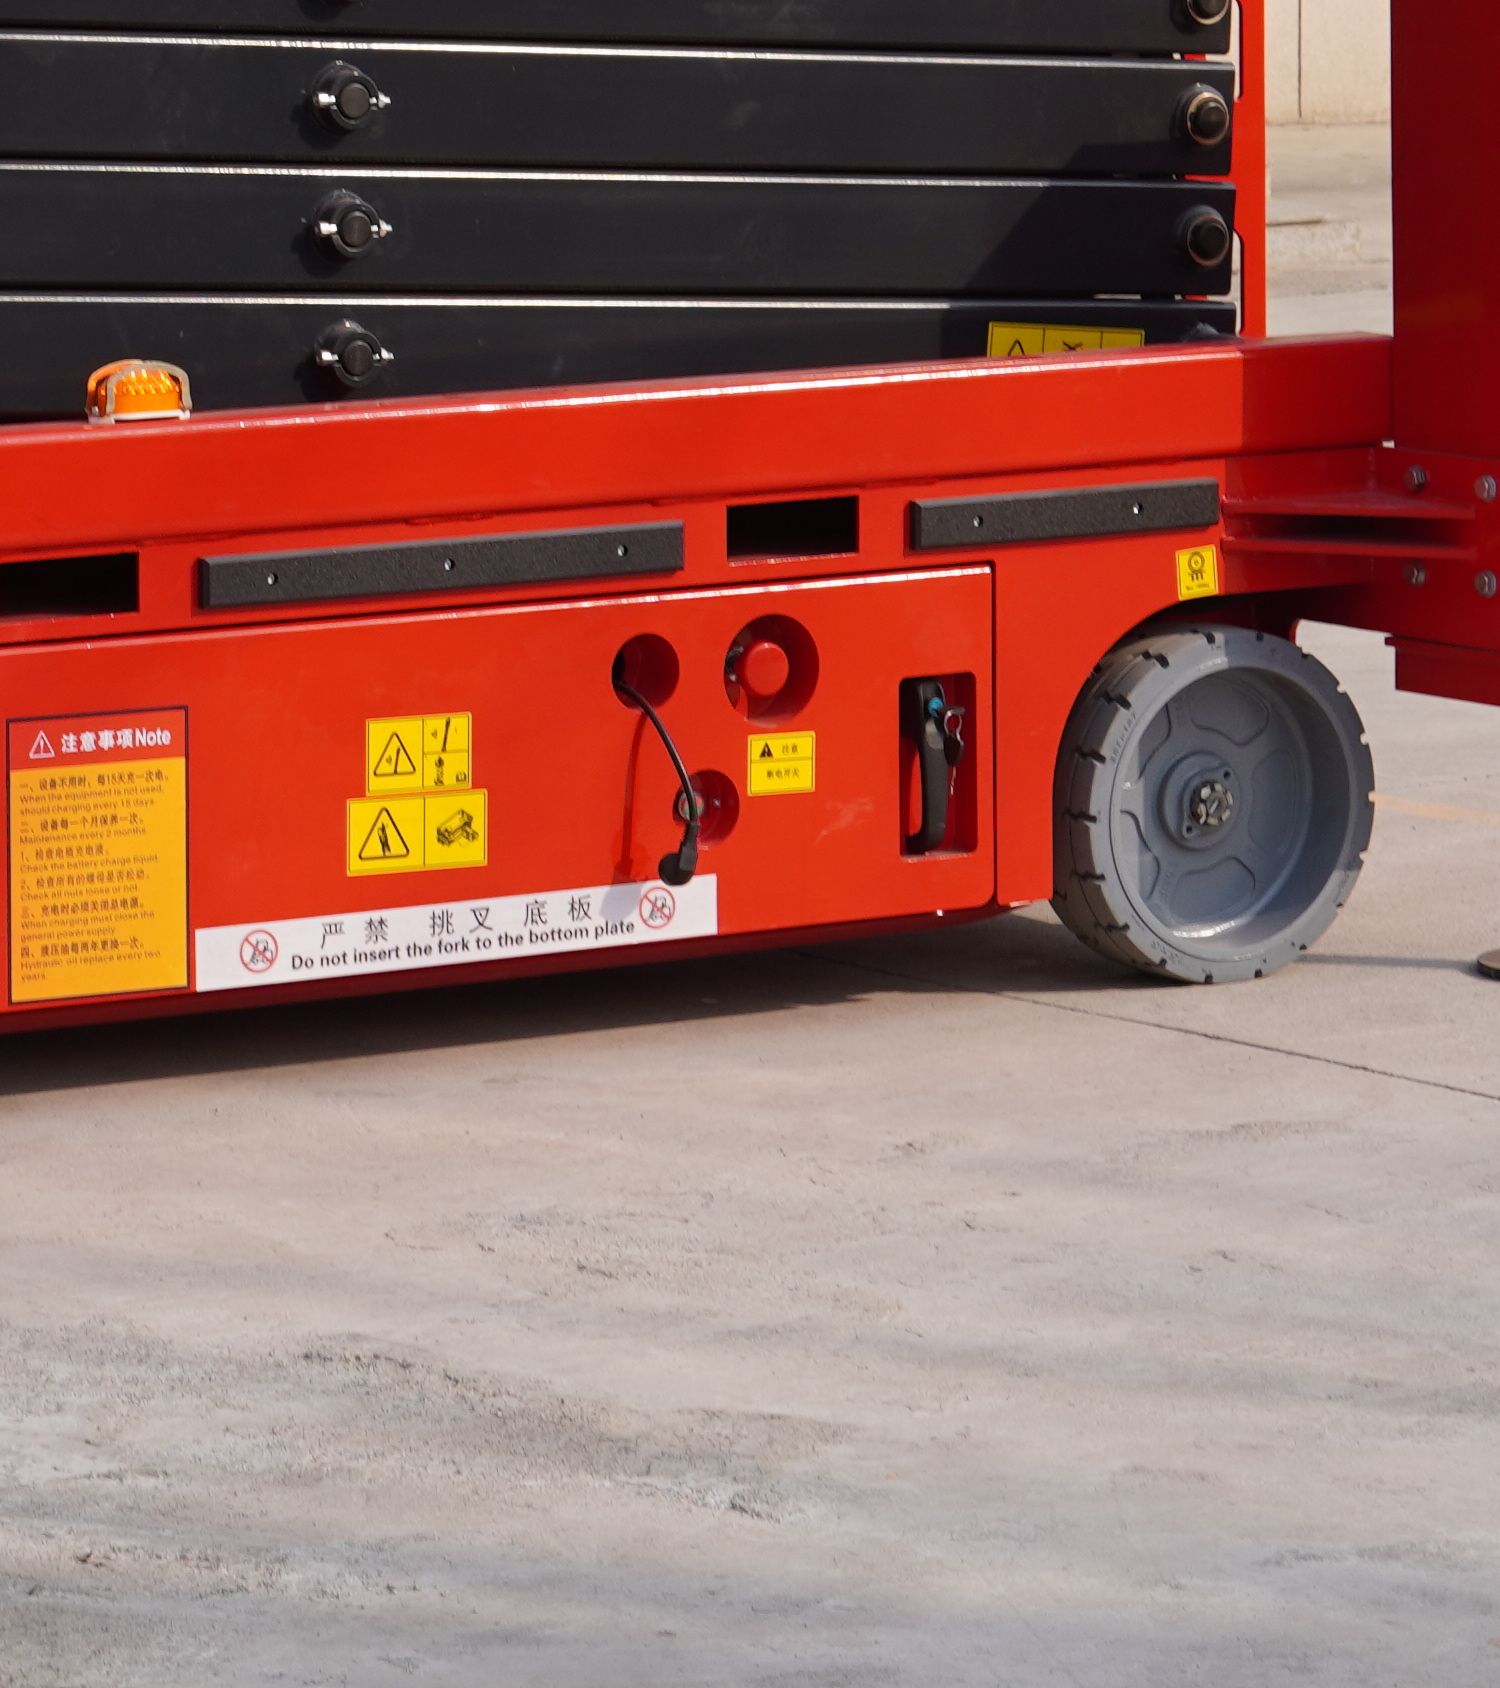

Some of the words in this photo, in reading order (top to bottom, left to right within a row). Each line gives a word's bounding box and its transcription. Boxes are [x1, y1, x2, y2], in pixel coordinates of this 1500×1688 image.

[60, 727, 172, 754] 注意事项Note
[19, 794, 46, 805] When
[48, 792, 62, 802] the
[64, 788, 112, 802] equipment
[123, 786, 138, 796] not
[51, 803, 92, 815] charging
[19, 863, 49, 874] Check
[51, 862, 65, 872] the
[67, 859, 99, 870] battery
[19, 891, 49, 902] Check
[291, 955, 314, 971] Do
[320, 950, 348, 968] not
[353, 946, 400, 964] insert
[406, 942, 433, 959] the
[438, 937, 470, 955] fork
[476, 935, 492, 951] to
[498, 931, 524, 947] the
[529, 926, 589, 945] bottom
[594, 920, 635, 941] plate
